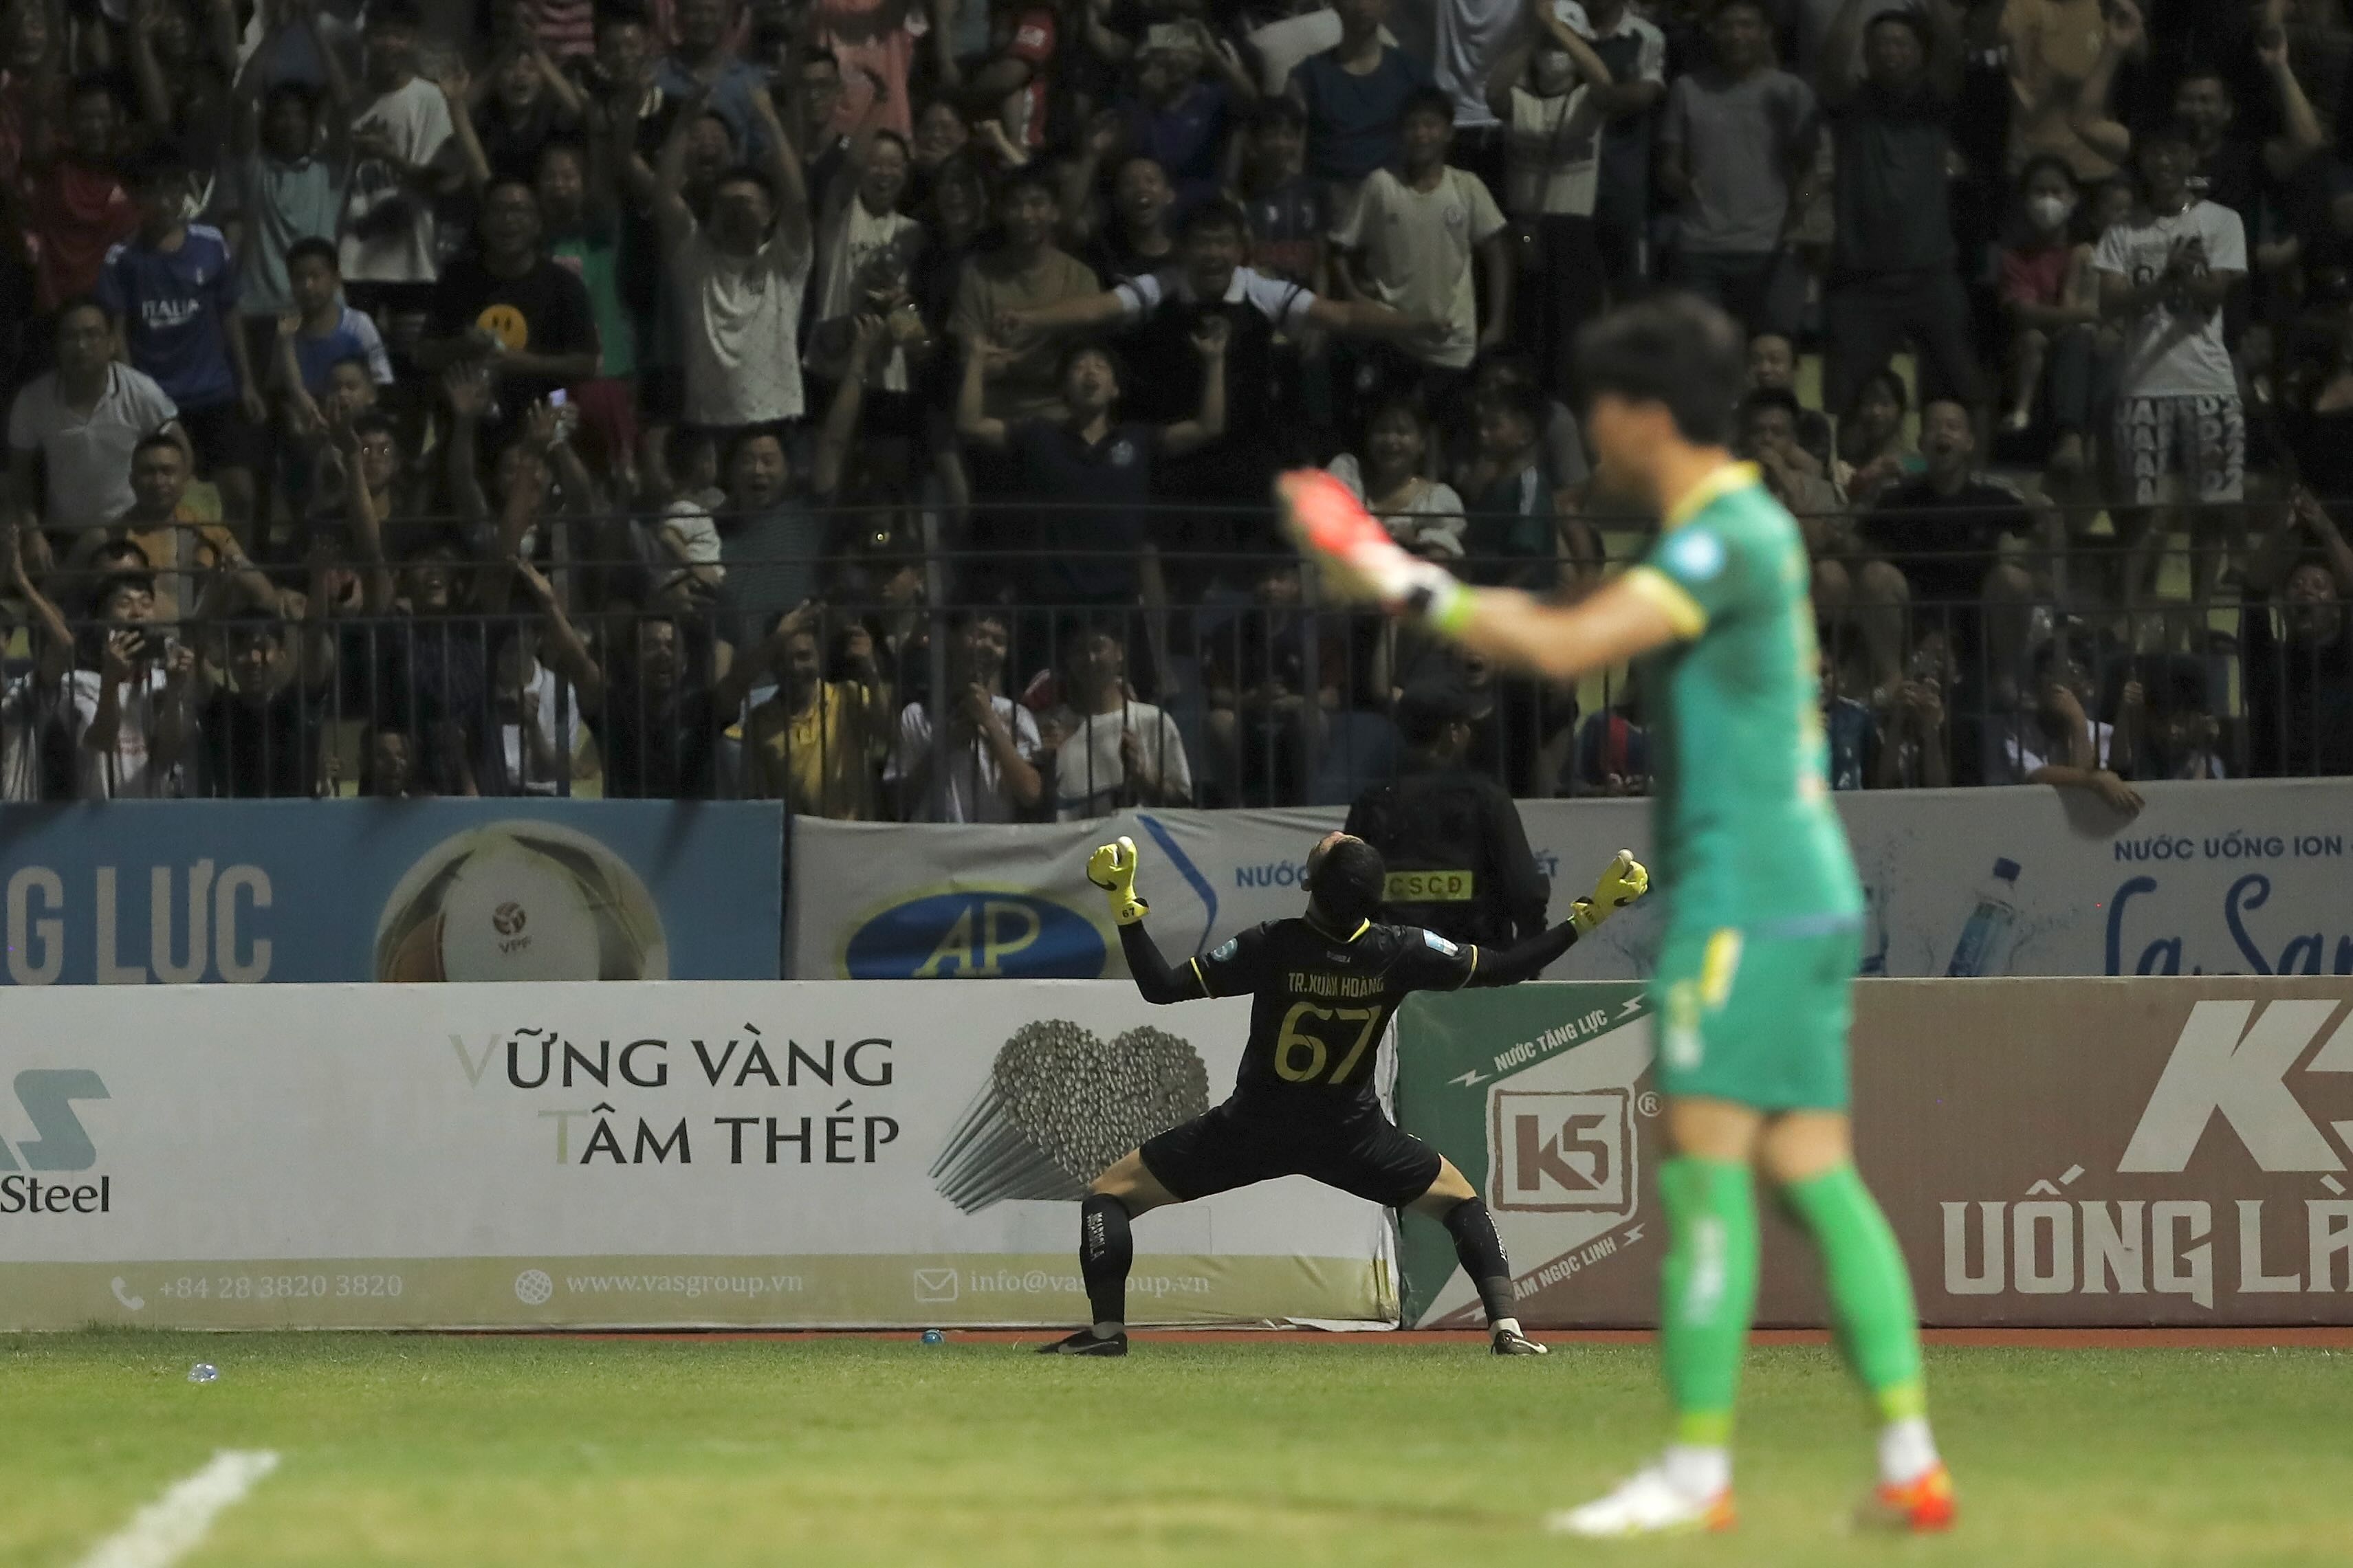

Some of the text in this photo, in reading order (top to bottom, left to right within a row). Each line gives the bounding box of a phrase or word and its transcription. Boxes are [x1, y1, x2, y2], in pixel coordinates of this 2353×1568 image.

[2115, 828, 2342, 860] NƯỚC UỐNG ION
[912, 901, 1040, 977] AP
[1121, 907, 1135, 918] 67
[448, 1022, 893, 1088] VỮNG VÀNG
[1274, 1001, 1382, 1084] 67
[1493, 1009, 1608, 1072] NƯỚC TĂNG LỰC
[538, 1099, 899, 1164] TÂM THÉP
[0, 1174, 110, 1213] Steel
[1939, 1164, 2213, 1310] UỐNG
[160, 1274, 403, 1299] +84 28 3820 3820
[566, 1274, 804, 1298] www.vasgroup.vn
[970, 1269, 1211, 1299] info@vasoup.vn
[1512, 1237, 1617, 1301] ÂM NGỌC LINH
